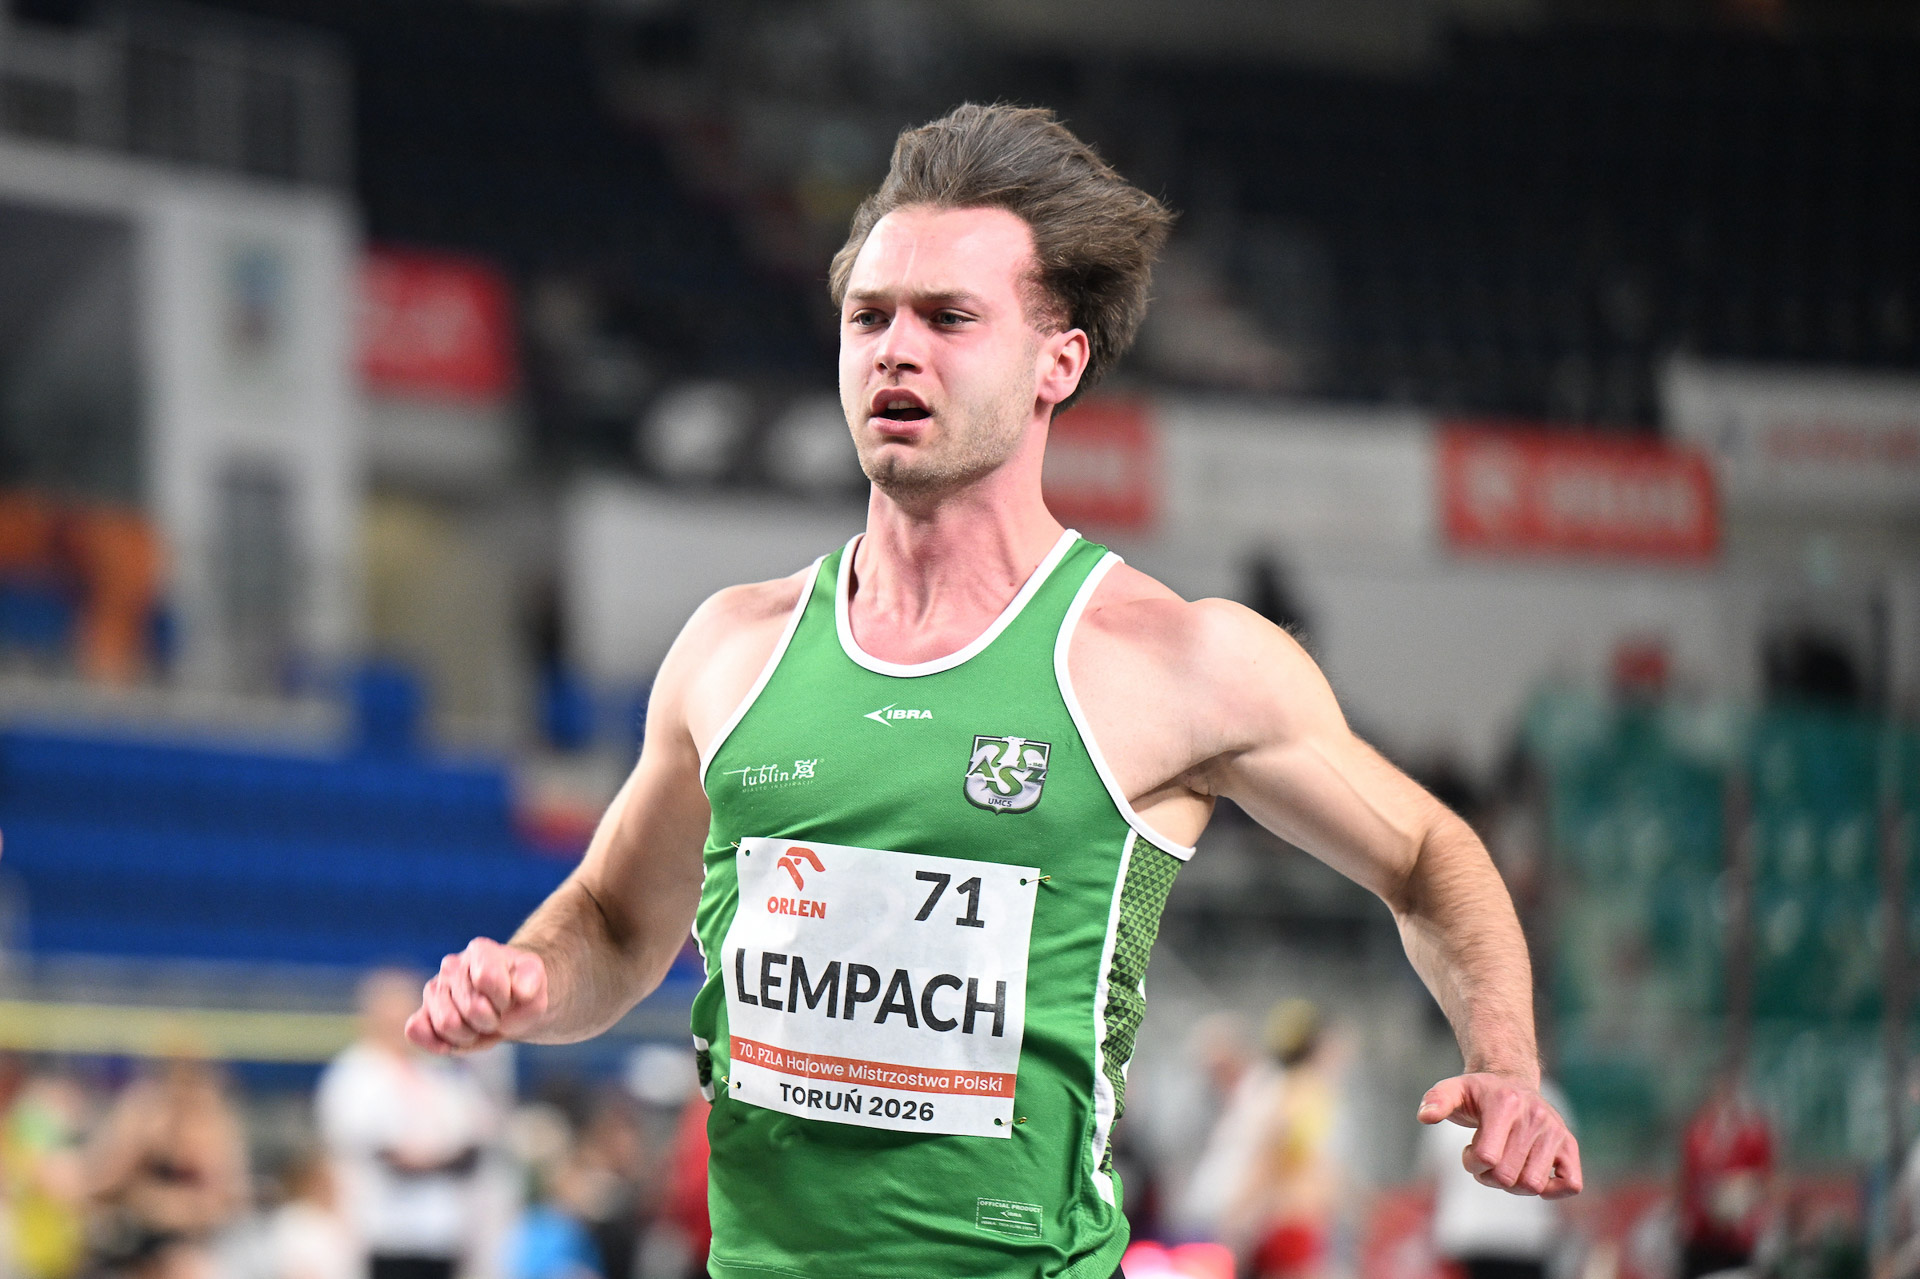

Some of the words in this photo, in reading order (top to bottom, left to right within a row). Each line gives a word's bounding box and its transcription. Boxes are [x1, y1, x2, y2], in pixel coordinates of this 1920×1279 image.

[887, 709, 933, 719] IBRA
[987, 797, 1012, 807] UMCS
[767, 896, 827, 919] ORLEN
[914, 870, 985, 928] 71
[735, 948, 1007, 1037] LEMPACH
[738, 1042, 756, 1060] 70.
[758, 1047, 784, 1067] PZLA
[787, 1055, 844, 1076] Halowe
[848, 1064, 950, 1089] Mistrzostwa
[954, 1075, 1003, 1092] Polski
[780, 1082, 863, 1114] TORUŃ
[868, 1096, 935, 1121] 2026
[980, 1200, 1011, 1209] OFFICIAL
[1011, 1204, 1041, 1213] PRODUCT
